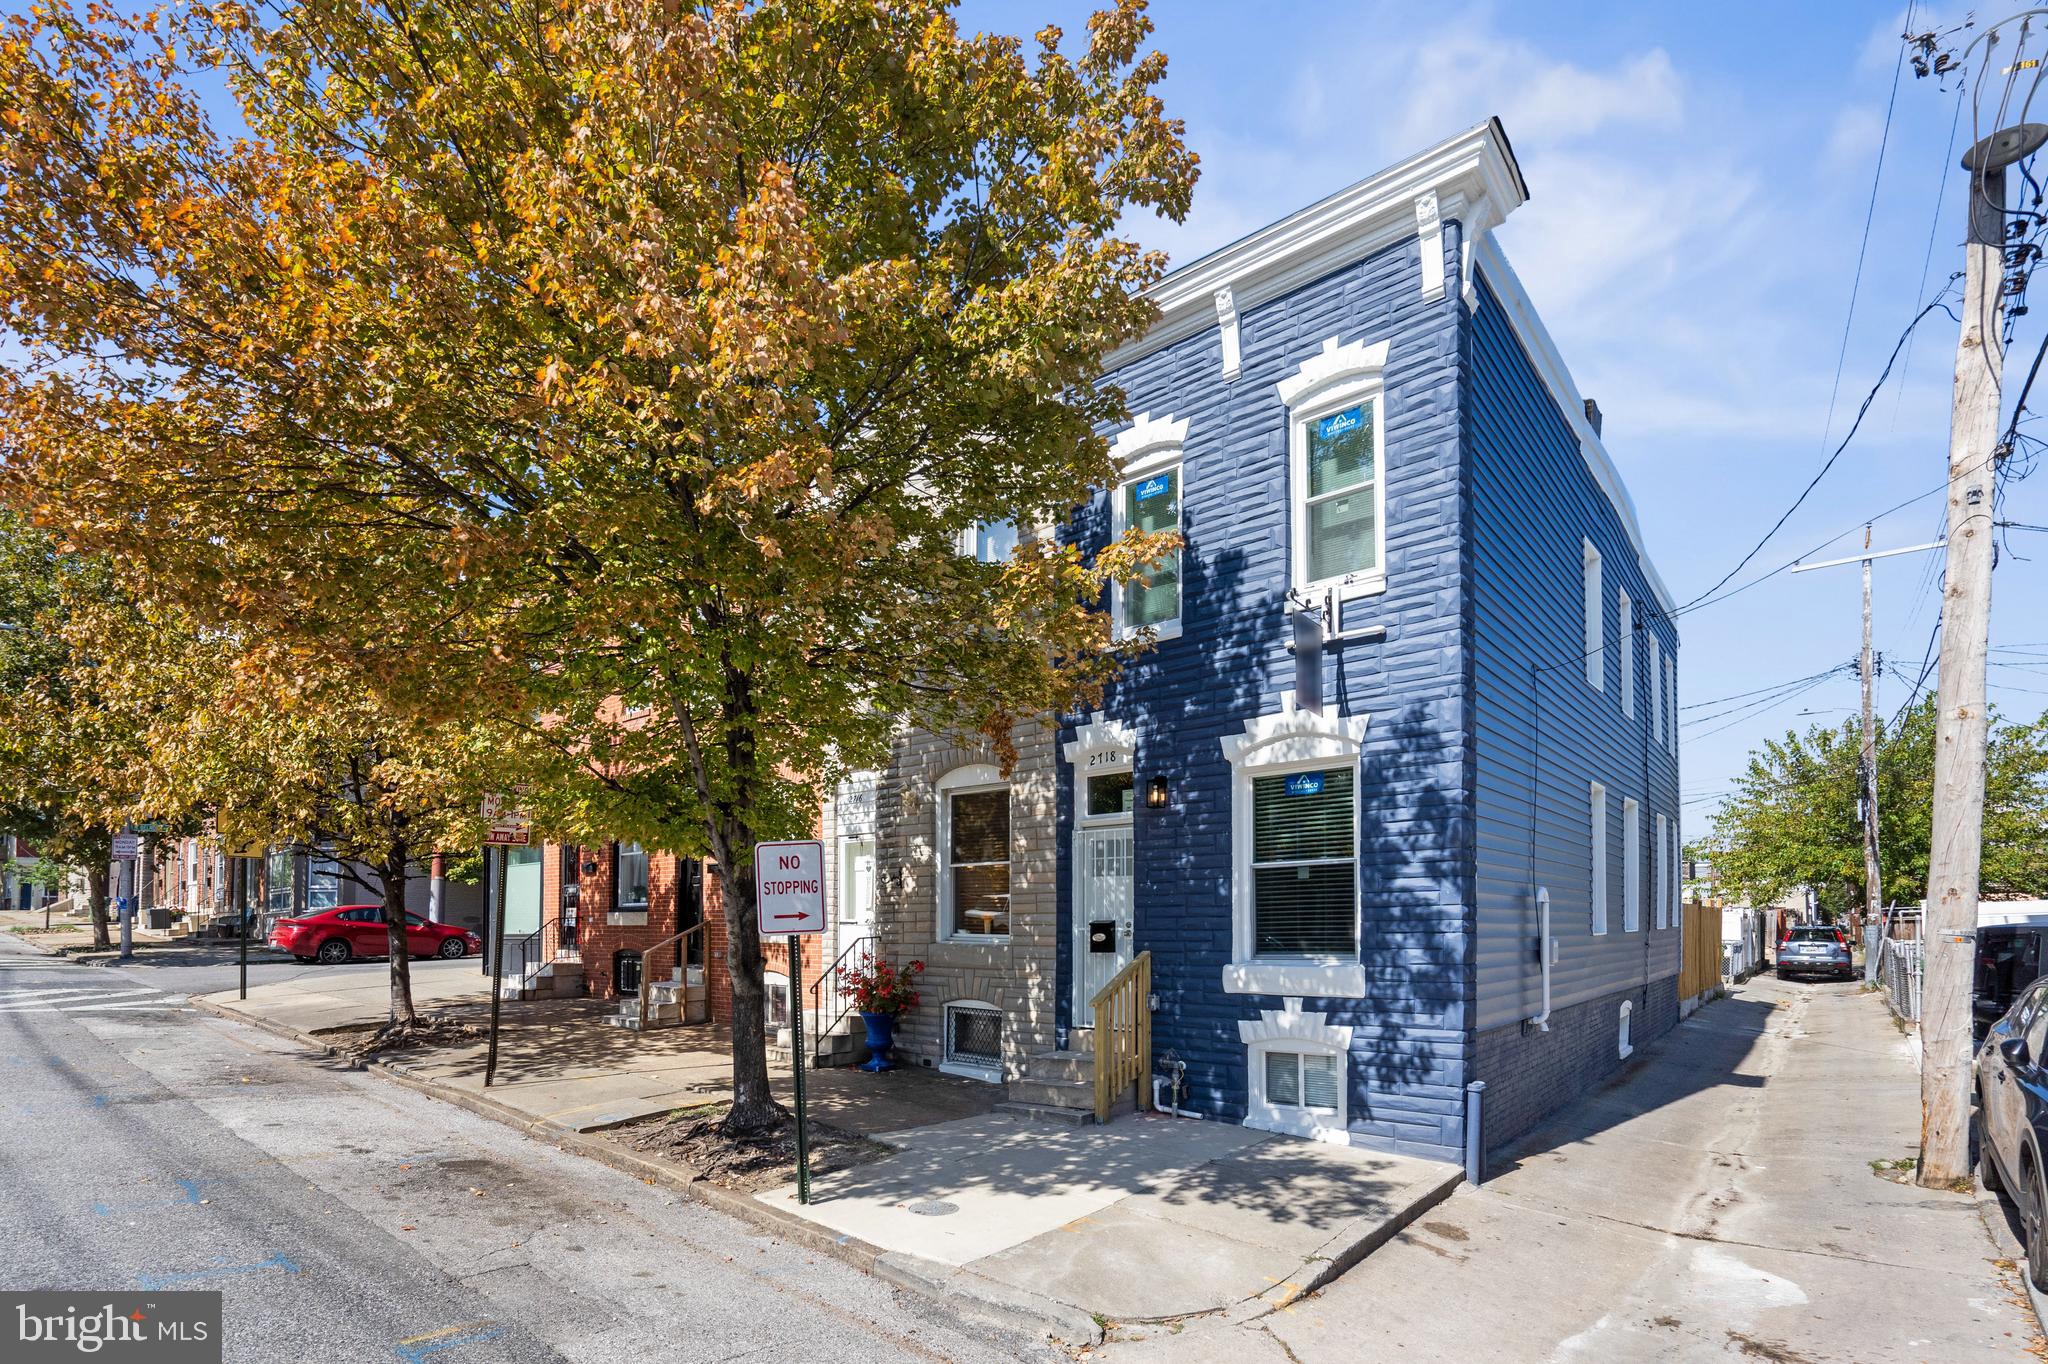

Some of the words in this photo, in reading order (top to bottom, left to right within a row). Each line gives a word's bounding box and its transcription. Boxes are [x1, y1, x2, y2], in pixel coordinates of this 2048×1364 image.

[1090, 750, 1116, 766] 2718
[779, 855, 800, 870] NO
[763, 879, 818, 895] STOPPING
